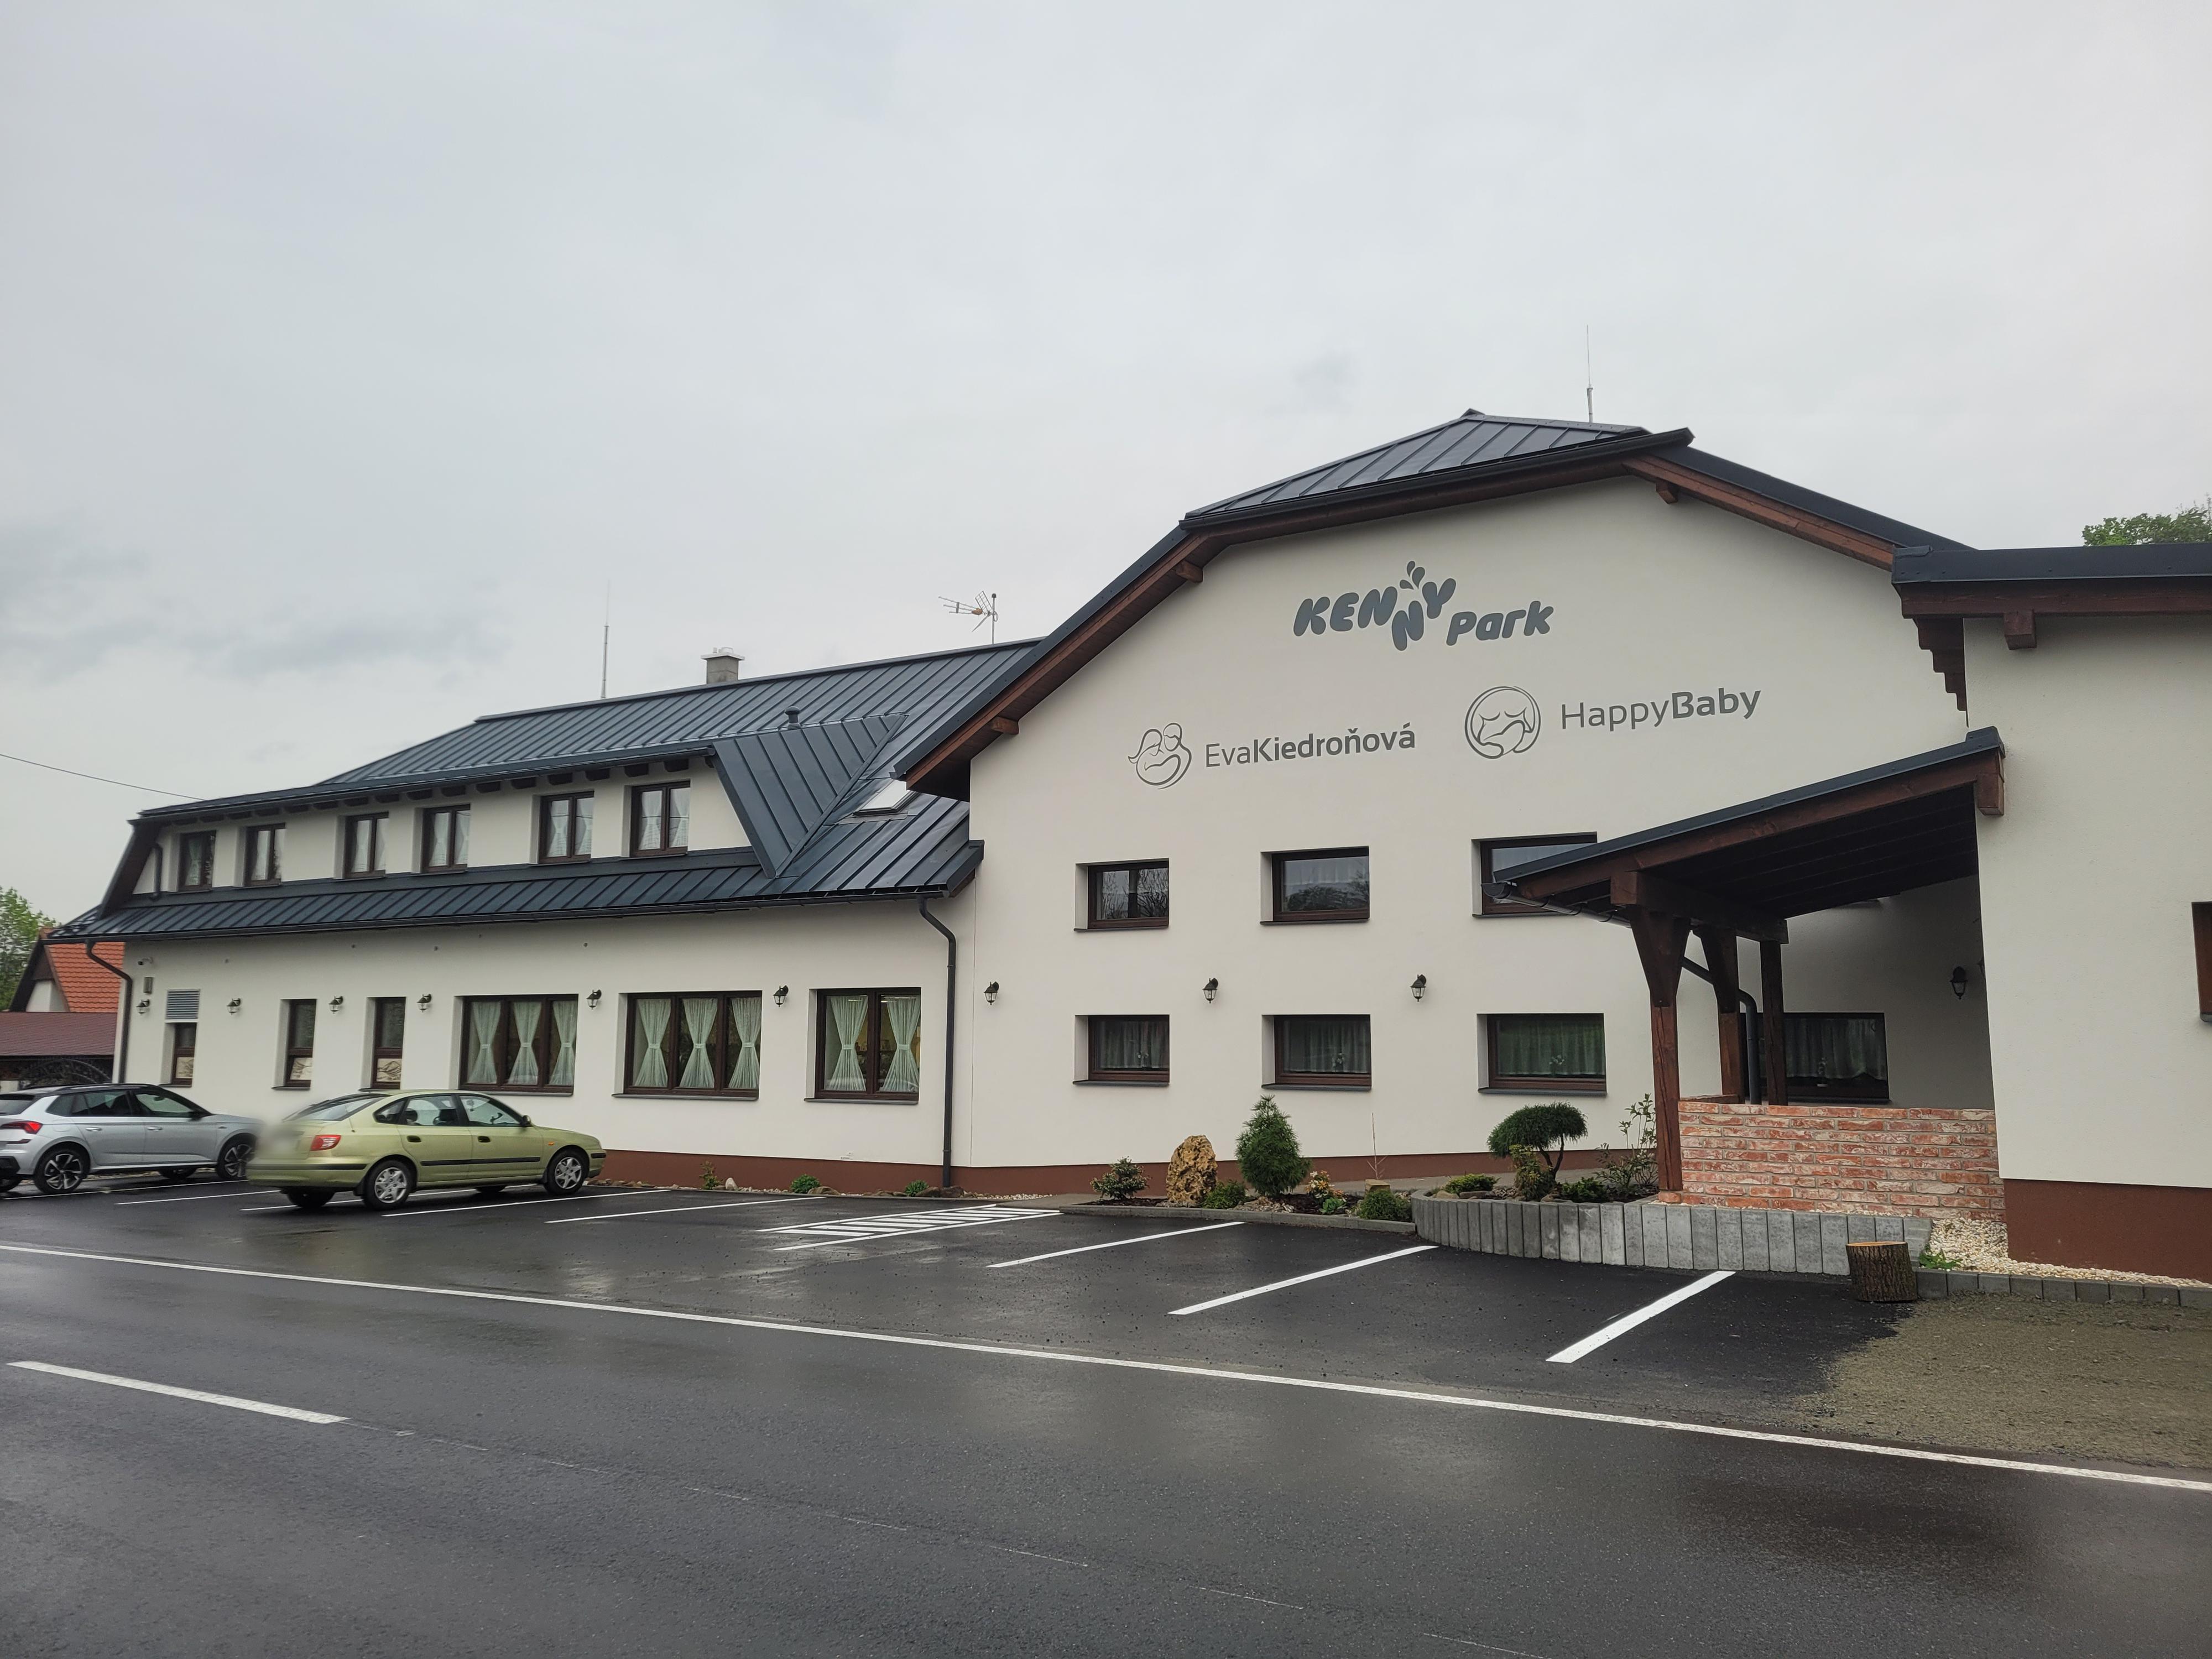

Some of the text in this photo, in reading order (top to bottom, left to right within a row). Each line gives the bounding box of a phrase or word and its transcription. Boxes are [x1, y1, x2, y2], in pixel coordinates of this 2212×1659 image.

[1292, 578, 1457, 651] KENNY
[1561, 687, 1762, 732] HappyBaby
[1205, 722, 1416, 768] EvaKiedroňová
